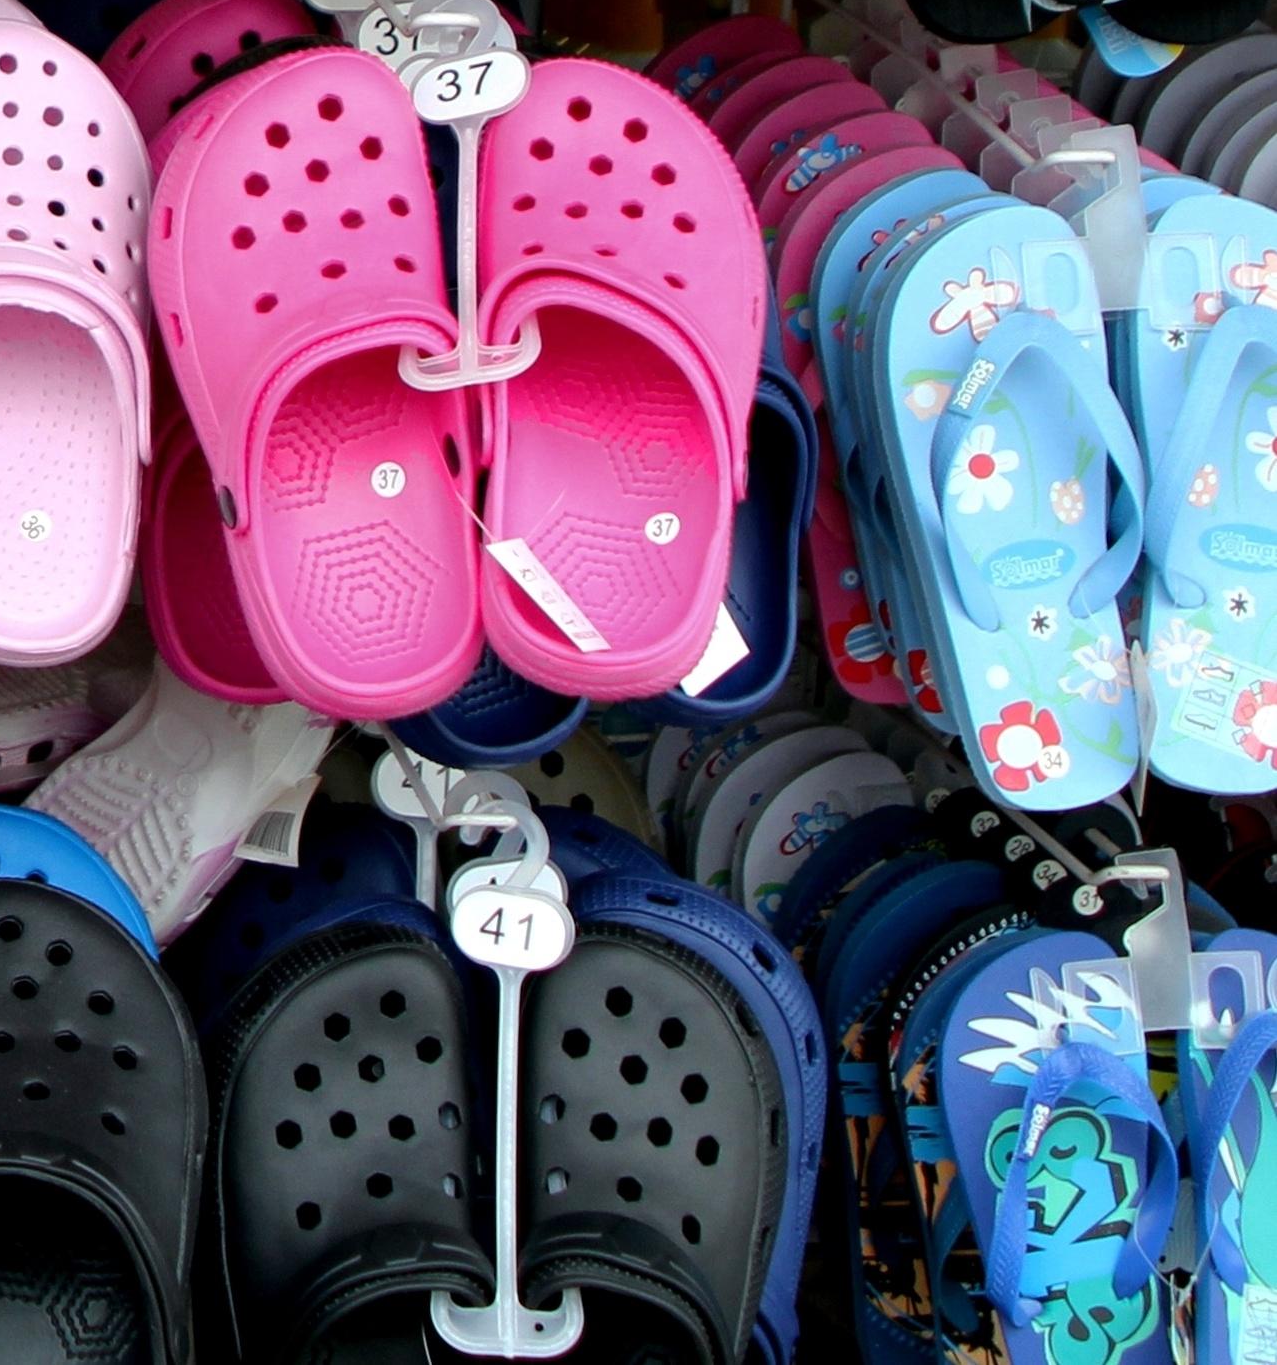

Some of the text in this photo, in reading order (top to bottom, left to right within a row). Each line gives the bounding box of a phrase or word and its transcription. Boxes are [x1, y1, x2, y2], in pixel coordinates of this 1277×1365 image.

[436, 60, 493, 103] 37
[378, 469, 400, 490] 37
[21, 516, 45, 540] 36
[651, 518, 674, 538] 37
[990, 553, 1060, 580] Solmar
[1042, 750, 1063, 770] 34
[479, 907, 534, 951] 41
